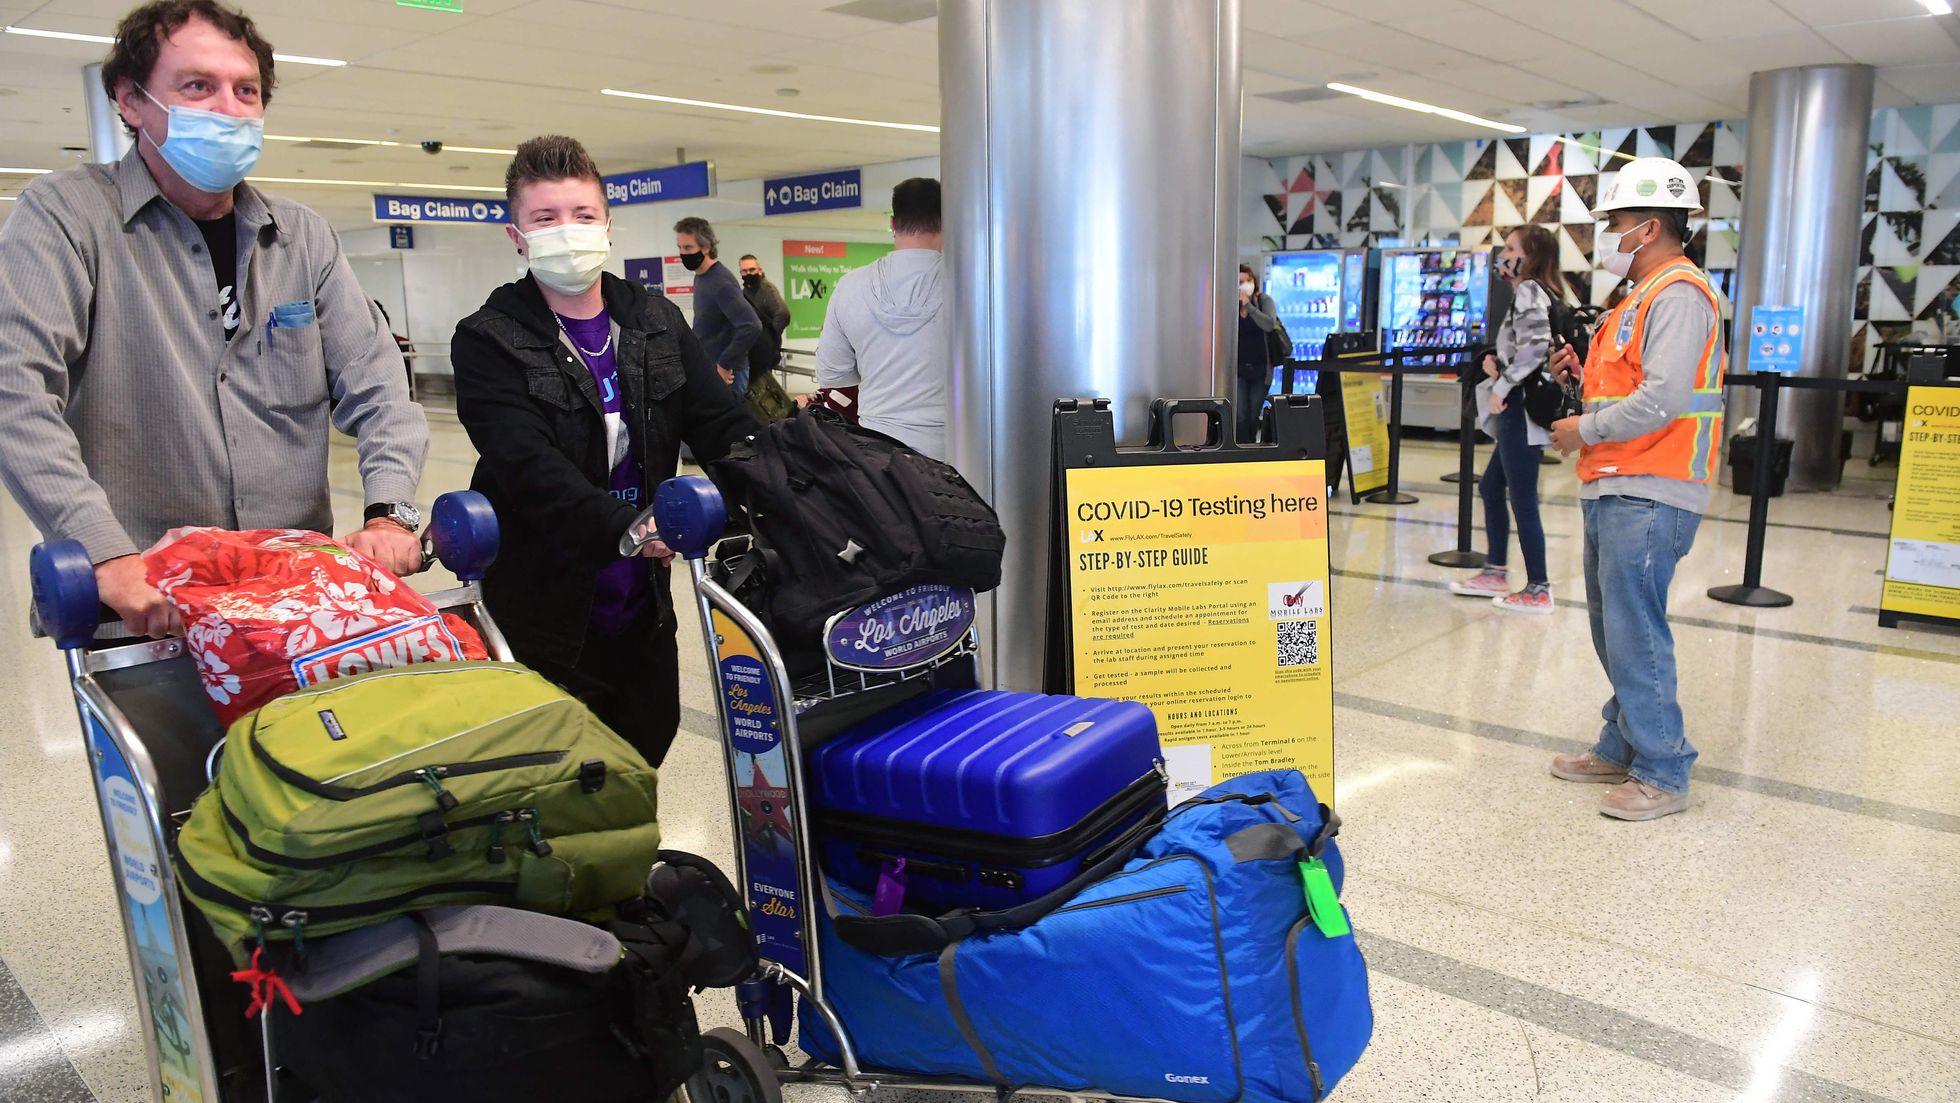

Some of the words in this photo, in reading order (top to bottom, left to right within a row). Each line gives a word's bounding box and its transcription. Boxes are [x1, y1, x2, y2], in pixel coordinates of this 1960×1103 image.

[606, 182, 628, 202] Bag
[629, 177, 662, 196] Claim
[794, 185, 818, 205] Bag
[821, 180, 858, 199] Claim
[388, 200, 421, 220] Bag
[424, 202, 470, 218] Claim
[804, 245, 824, 254] New!
[791, 264, 807, 273] Walk
[819, 264, 832, 275] Way
[1913, 404, 1960, 417] COVID
[1077, 498, 1183, 522] COVID-19
[1188, 495, 1266, 519] Testing
[1271, 493, 1318, 513] here
[1080, 529, 1104, 543] LAX
[1110, 532, 1192, 542] www.FlyLAX.com/TravelSafely
[1080, 549, 1168, 571] STEP-BY-STEP
[1173, 548, 1208, 566] GUIDE
[864, 593, 903, 616] WELCOME
[918, 584, 950, 593] FRIENDLY
[1195, 610, 1236, 618] appointment
[855, 618, 895, 653] Los
[900, 597, 962, 635] Angeles
[1106, 632, 1134, 640] required
[884, 643, 913, 657] WORLD
[913, 631, 948, 649] AIRPORTS
[731, 665, 760, 675] WELCOME
[734, 674, 761, 684] FRIENDLY
[1094, 680, 1127, 688] processed
[728, 684, 748, 700] Los
[730, 700, 772, 716] Angeles
[1168, 712, 1187, 720] HOURS
[1205, 708, 1238, 717] LOCATIONS
[734, 717, 762, 729] WORLD
[735, 728, 774, 742] AIRPORTS
[1221, 742, 1242, 750] Across
[1261, 738, 1290, 746] Terminal
[1222, 750, 1267, 759] Lower/Arrivals
[1222, 761, 1241, 769] Inside
[754, 882, 795, 900] EVERYONE
[761, 898, 797, 919] Star
[1165, 1073, 1210, 1084] Gonex
